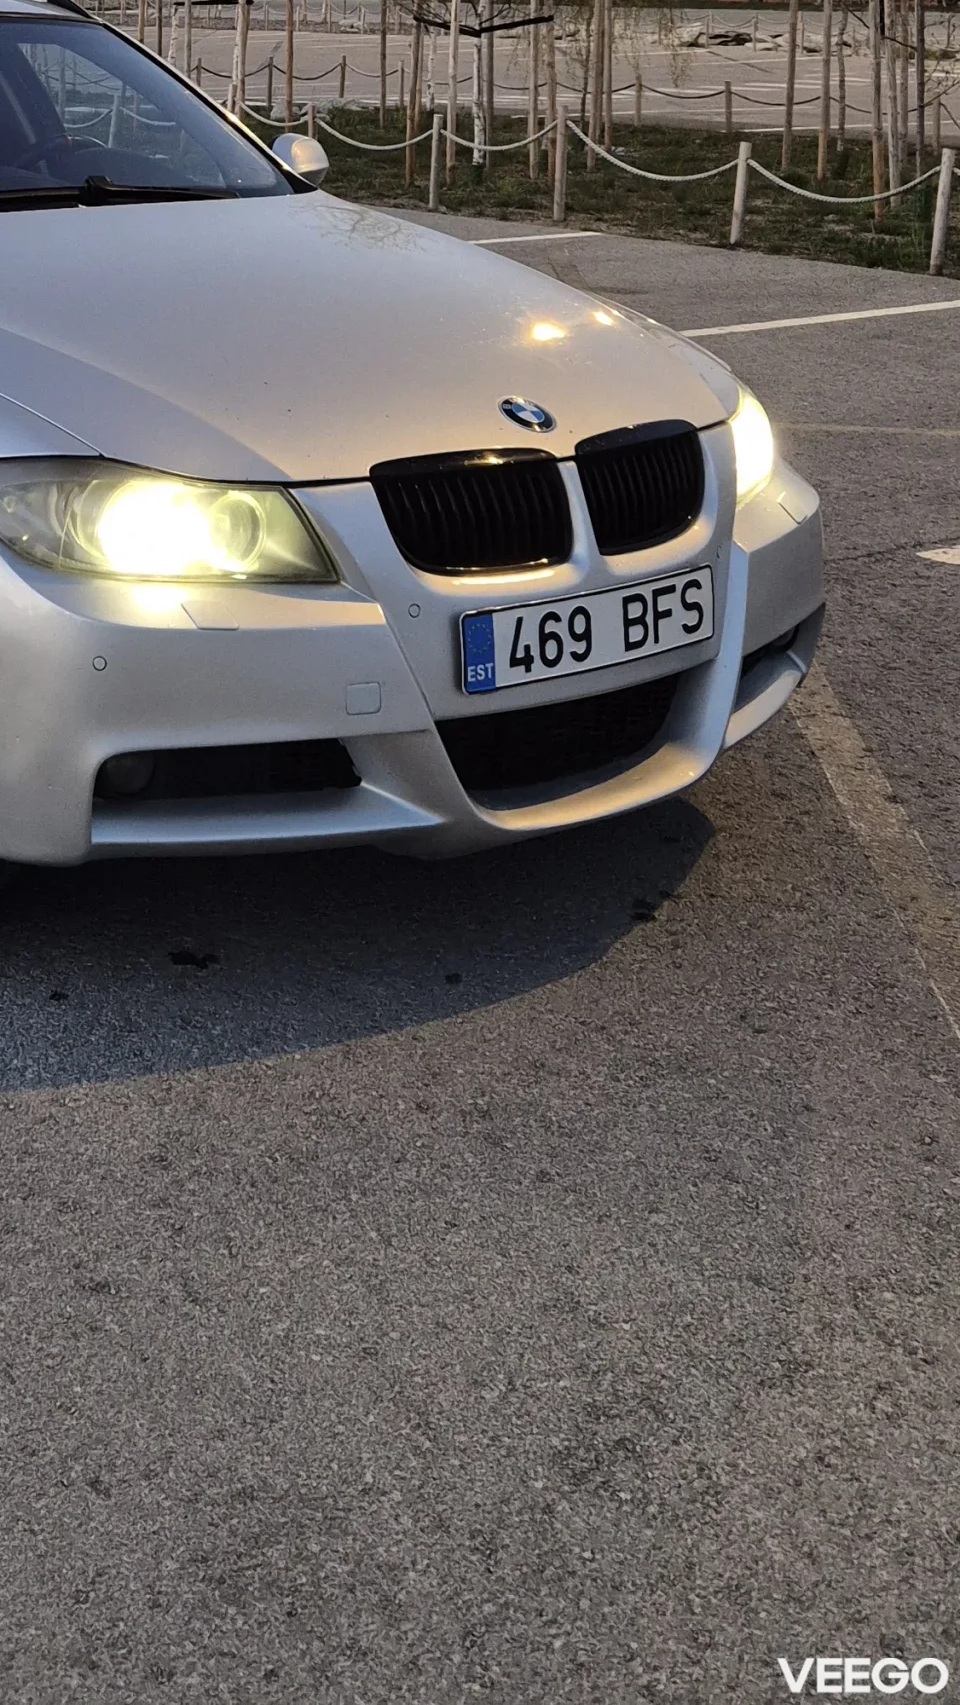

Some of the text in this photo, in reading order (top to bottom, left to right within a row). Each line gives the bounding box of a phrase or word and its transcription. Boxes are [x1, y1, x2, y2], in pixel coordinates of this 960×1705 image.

[509, 579, 704, 673] 469 BFS
[468, 663, 494, 682] EST
